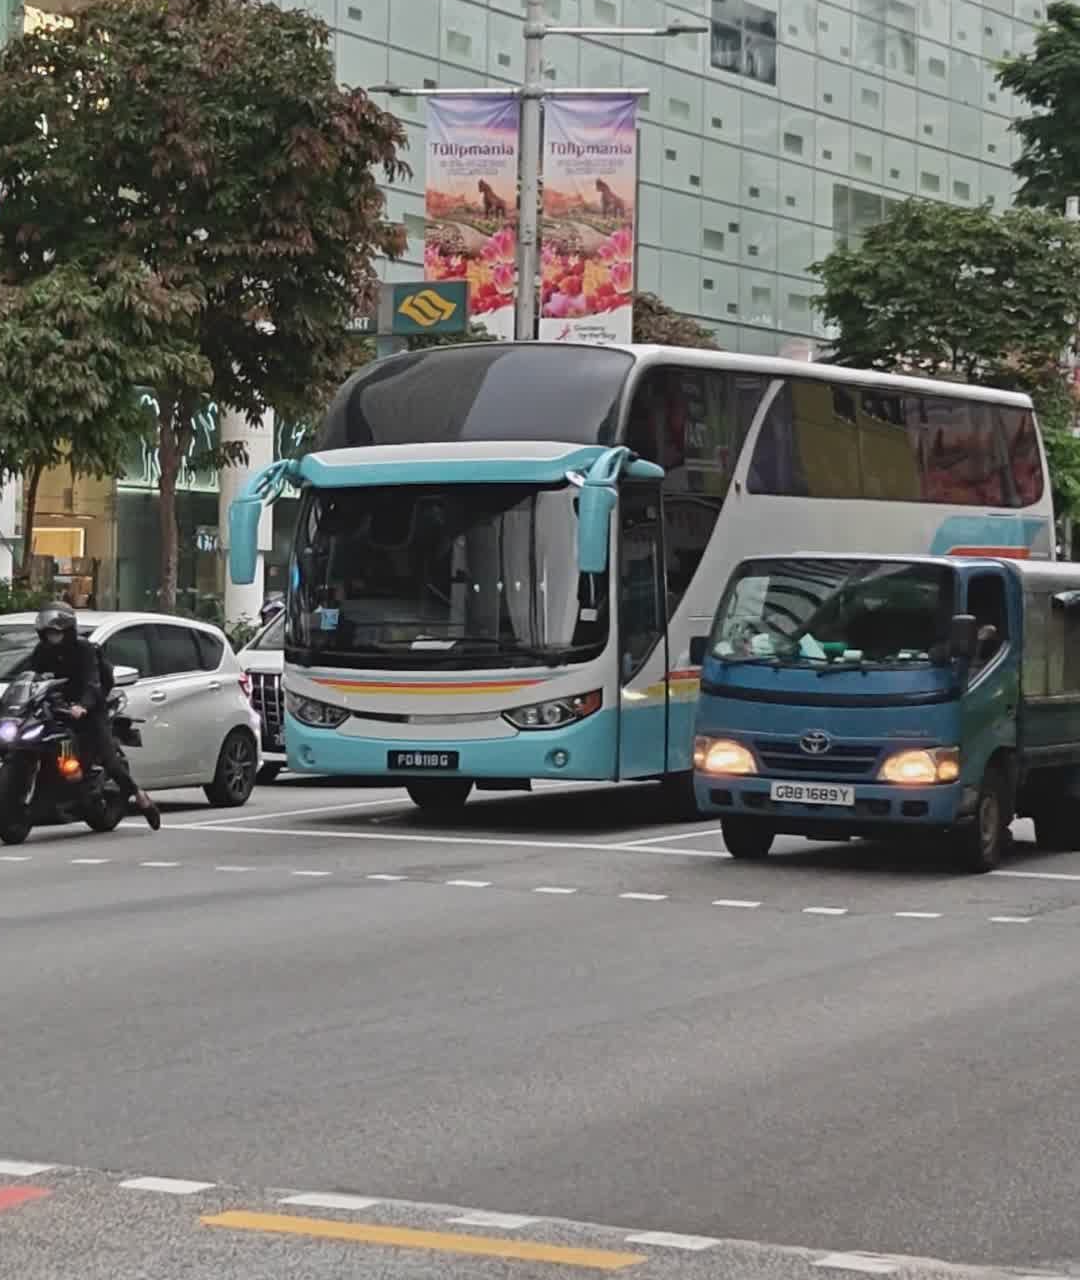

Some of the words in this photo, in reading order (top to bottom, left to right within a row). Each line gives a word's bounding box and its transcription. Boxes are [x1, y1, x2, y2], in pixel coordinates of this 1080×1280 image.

[431, 141, 515, 158] Tulipmania
[549, 141, 633, 158] Tulipmania
[775, 785, 849, 802] GBB1689Y
